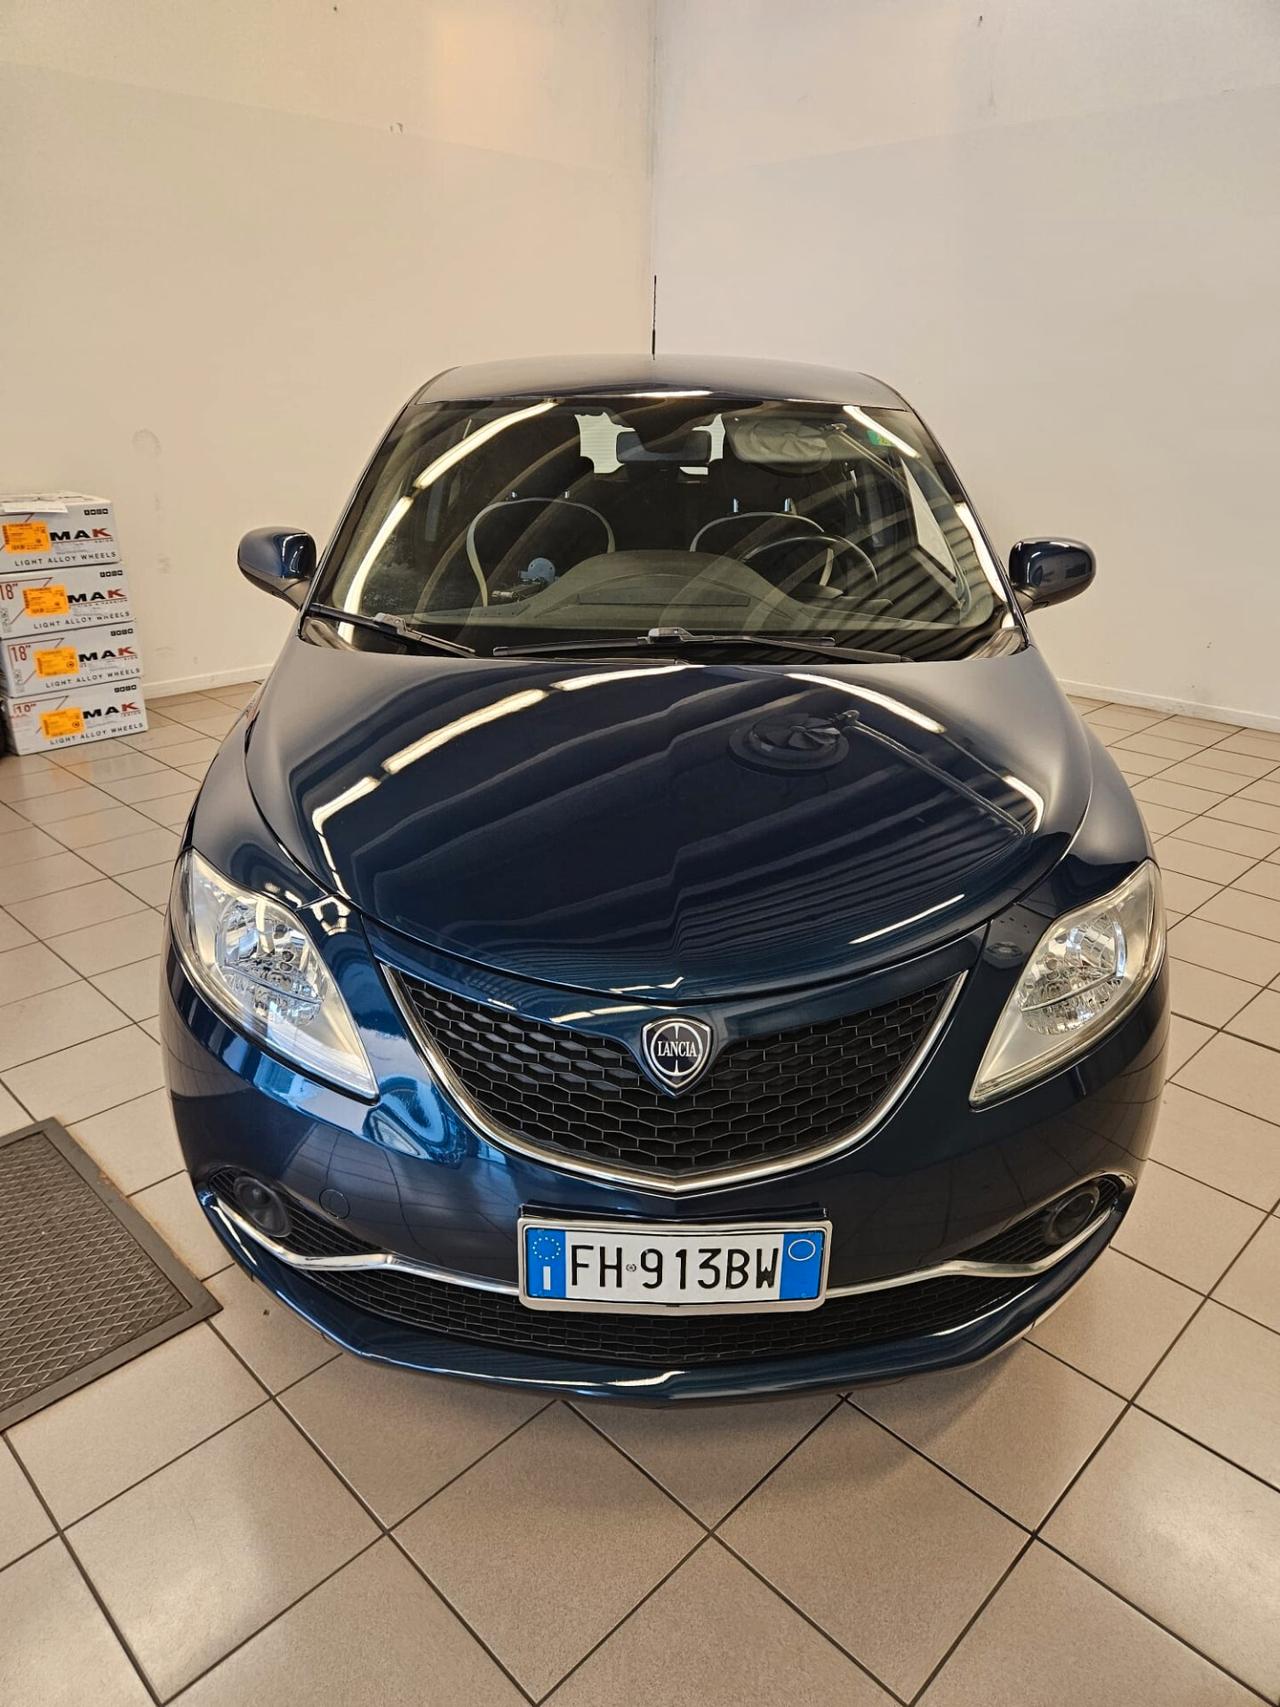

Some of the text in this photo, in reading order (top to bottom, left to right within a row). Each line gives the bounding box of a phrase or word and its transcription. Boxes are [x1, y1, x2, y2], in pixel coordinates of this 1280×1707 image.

[50, 528, 112, 541] MAK
[14, 551, 117, 567] LIGHT ALLOY WHEELS
[67, 588, 127, 604] MAK
[33, 611, 130, 629] LIGHT ALLOY WHEELS
[78, 646, 136, 662] MAK
[45, 667, 140, 688] LIGHT ALLOY WHEELS
[82, 702, 139, 719] MAK
[49, 722, 144, 745] LIGHT ALLOY WHEELS
[657, 1041, 698, 1057] LANCIA
